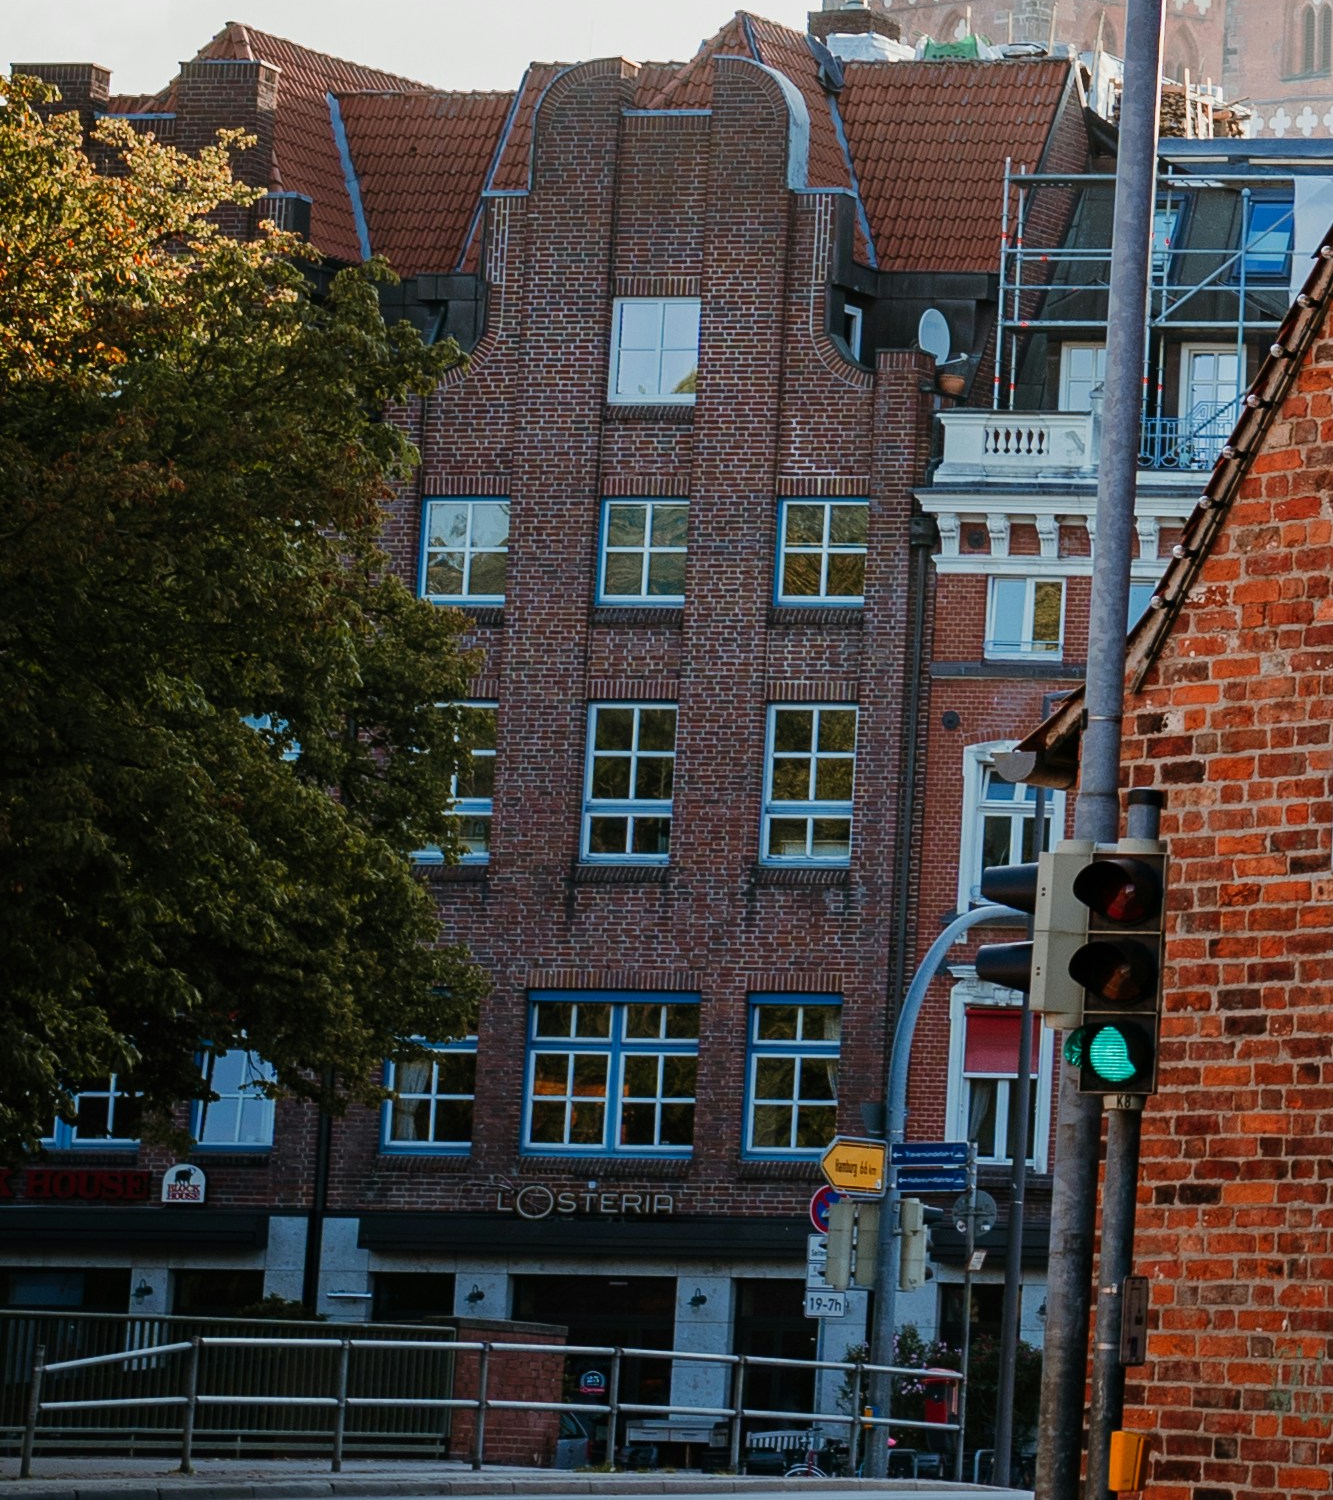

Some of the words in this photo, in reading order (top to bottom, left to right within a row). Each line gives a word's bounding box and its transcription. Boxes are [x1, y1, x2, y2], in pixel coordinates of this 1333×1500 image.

[1116, 1094, 1132, 1109] K8
[835, 1158, 858, 1178] Hamburg
[860, 1160, 868, 1175] 66
[869, 1164, 877, 1176] km
[25, 1169, 151, 1200] HOUSE
[168, 1184, 200, 1193] BLOCK
[167, 1192, 200, 1200] HOUSE
[810, 1297, 842, 1311] 19-7h
